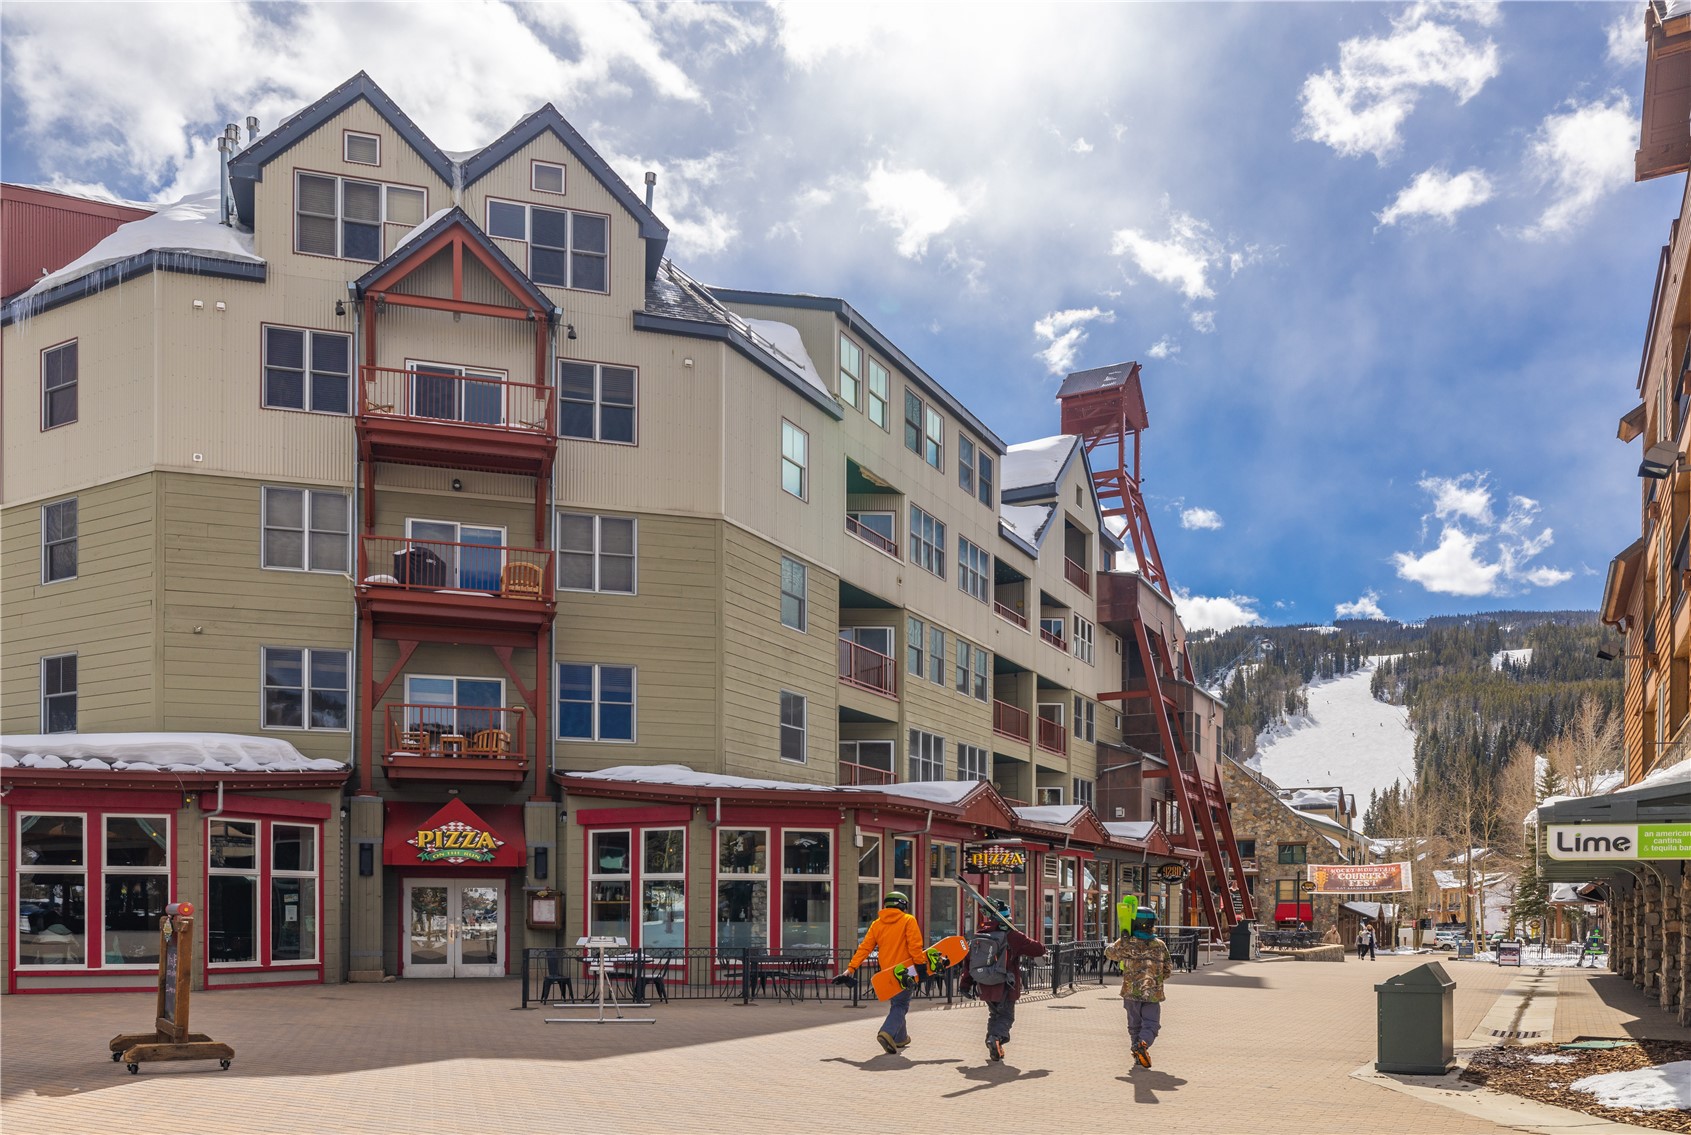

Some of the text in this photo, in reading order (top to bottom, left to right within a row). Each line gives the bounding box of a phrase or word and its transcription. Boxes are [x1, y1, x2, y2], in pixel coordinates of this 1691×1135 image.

[417, 830, 497, 849] PIZZA
[1557, 832, 1631, 852] Lime
[463, 852, 481, 860] RUN
[972, 853, 1024, 865] PIZZA
[1338, 872, 1388, 880] COUNTRY
